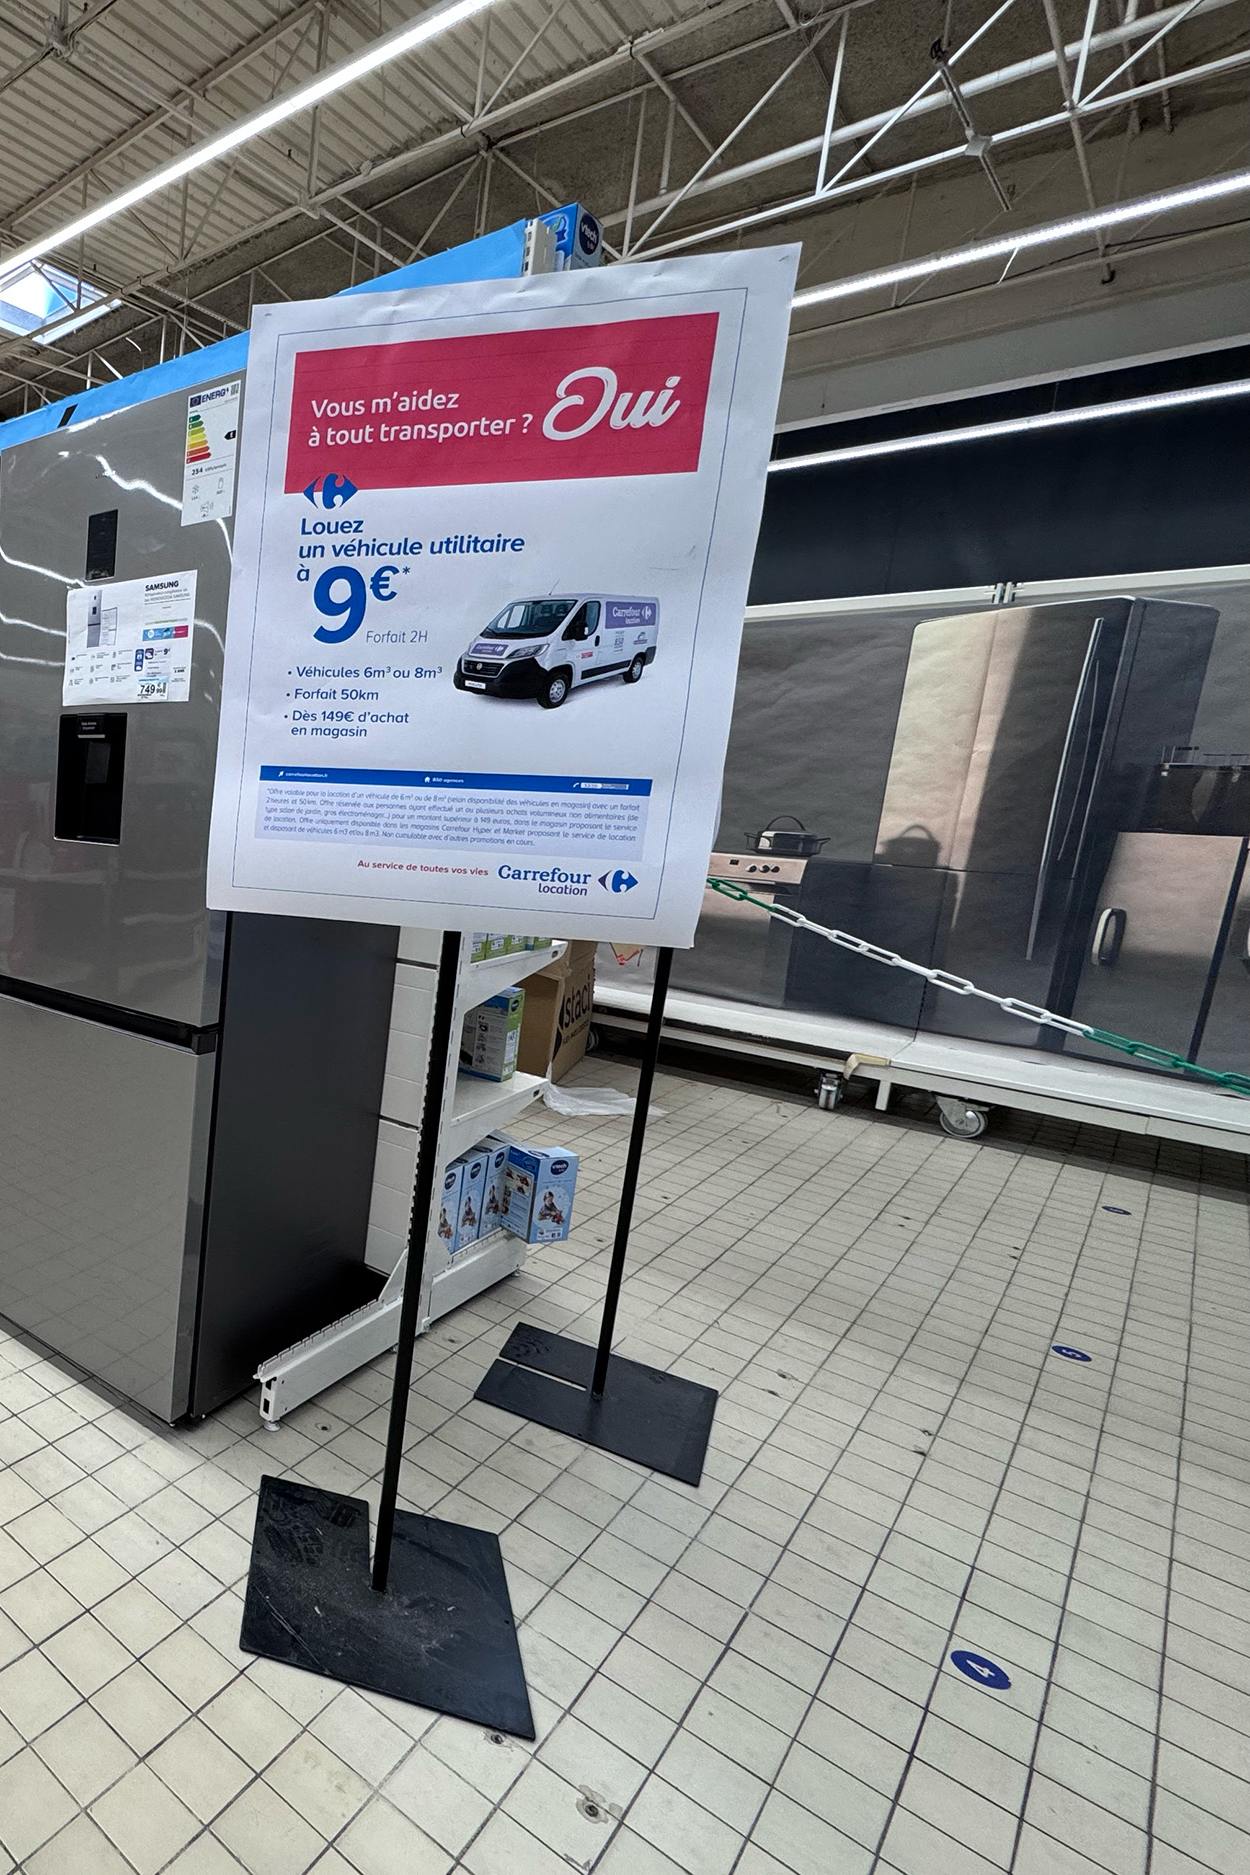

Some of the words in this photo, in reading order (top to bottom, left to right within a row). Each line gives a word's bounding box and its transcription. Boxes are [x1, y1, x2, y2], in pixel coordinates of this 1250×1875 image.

[311, 398, 367, 418] Vous
[541, 366, 682, 442] Oui
[308, 426, 322, 448] à
[326, 424, 374, 445] tout
[379, 416, 516, 444] transporter
[521, 414, 533, 436] ?
[301, 517, 364, 536] Louez
[298, 543, 326, 559] un
[330, 536, 424, 558] véhicule
[429, 533, 526, 556] utilitaire
[296, 564, 310, 582] à
[145, 580, 179, 592] SAMSUNG
[366, 629, 404, 644] Forfait
[407, 629, 428, 643] 2H
[296, 665, 360, 680] Véhicules
[392, 669, 412, 679] ou
[294, 688, 338, 701] Forfait
[341, 688, 380, 702] 50km
[292, 709, 317, 723] Dès
[320, 711, 354, 724] 149€
[291, 727, 306, 737] en
[310, 726, 368, 740] magasin
[358, 860, 370, 868] Au
[372, 862, 404, 870] service
[406, 863, 418, 872] de
[420, 864, 449, 874] toutes
[470, 868, 489, 876] vies
[498, 864, 592, 885] Carrefour
[538, 883, 588, 896] location
[966, 1660, 996, 1678] 4
